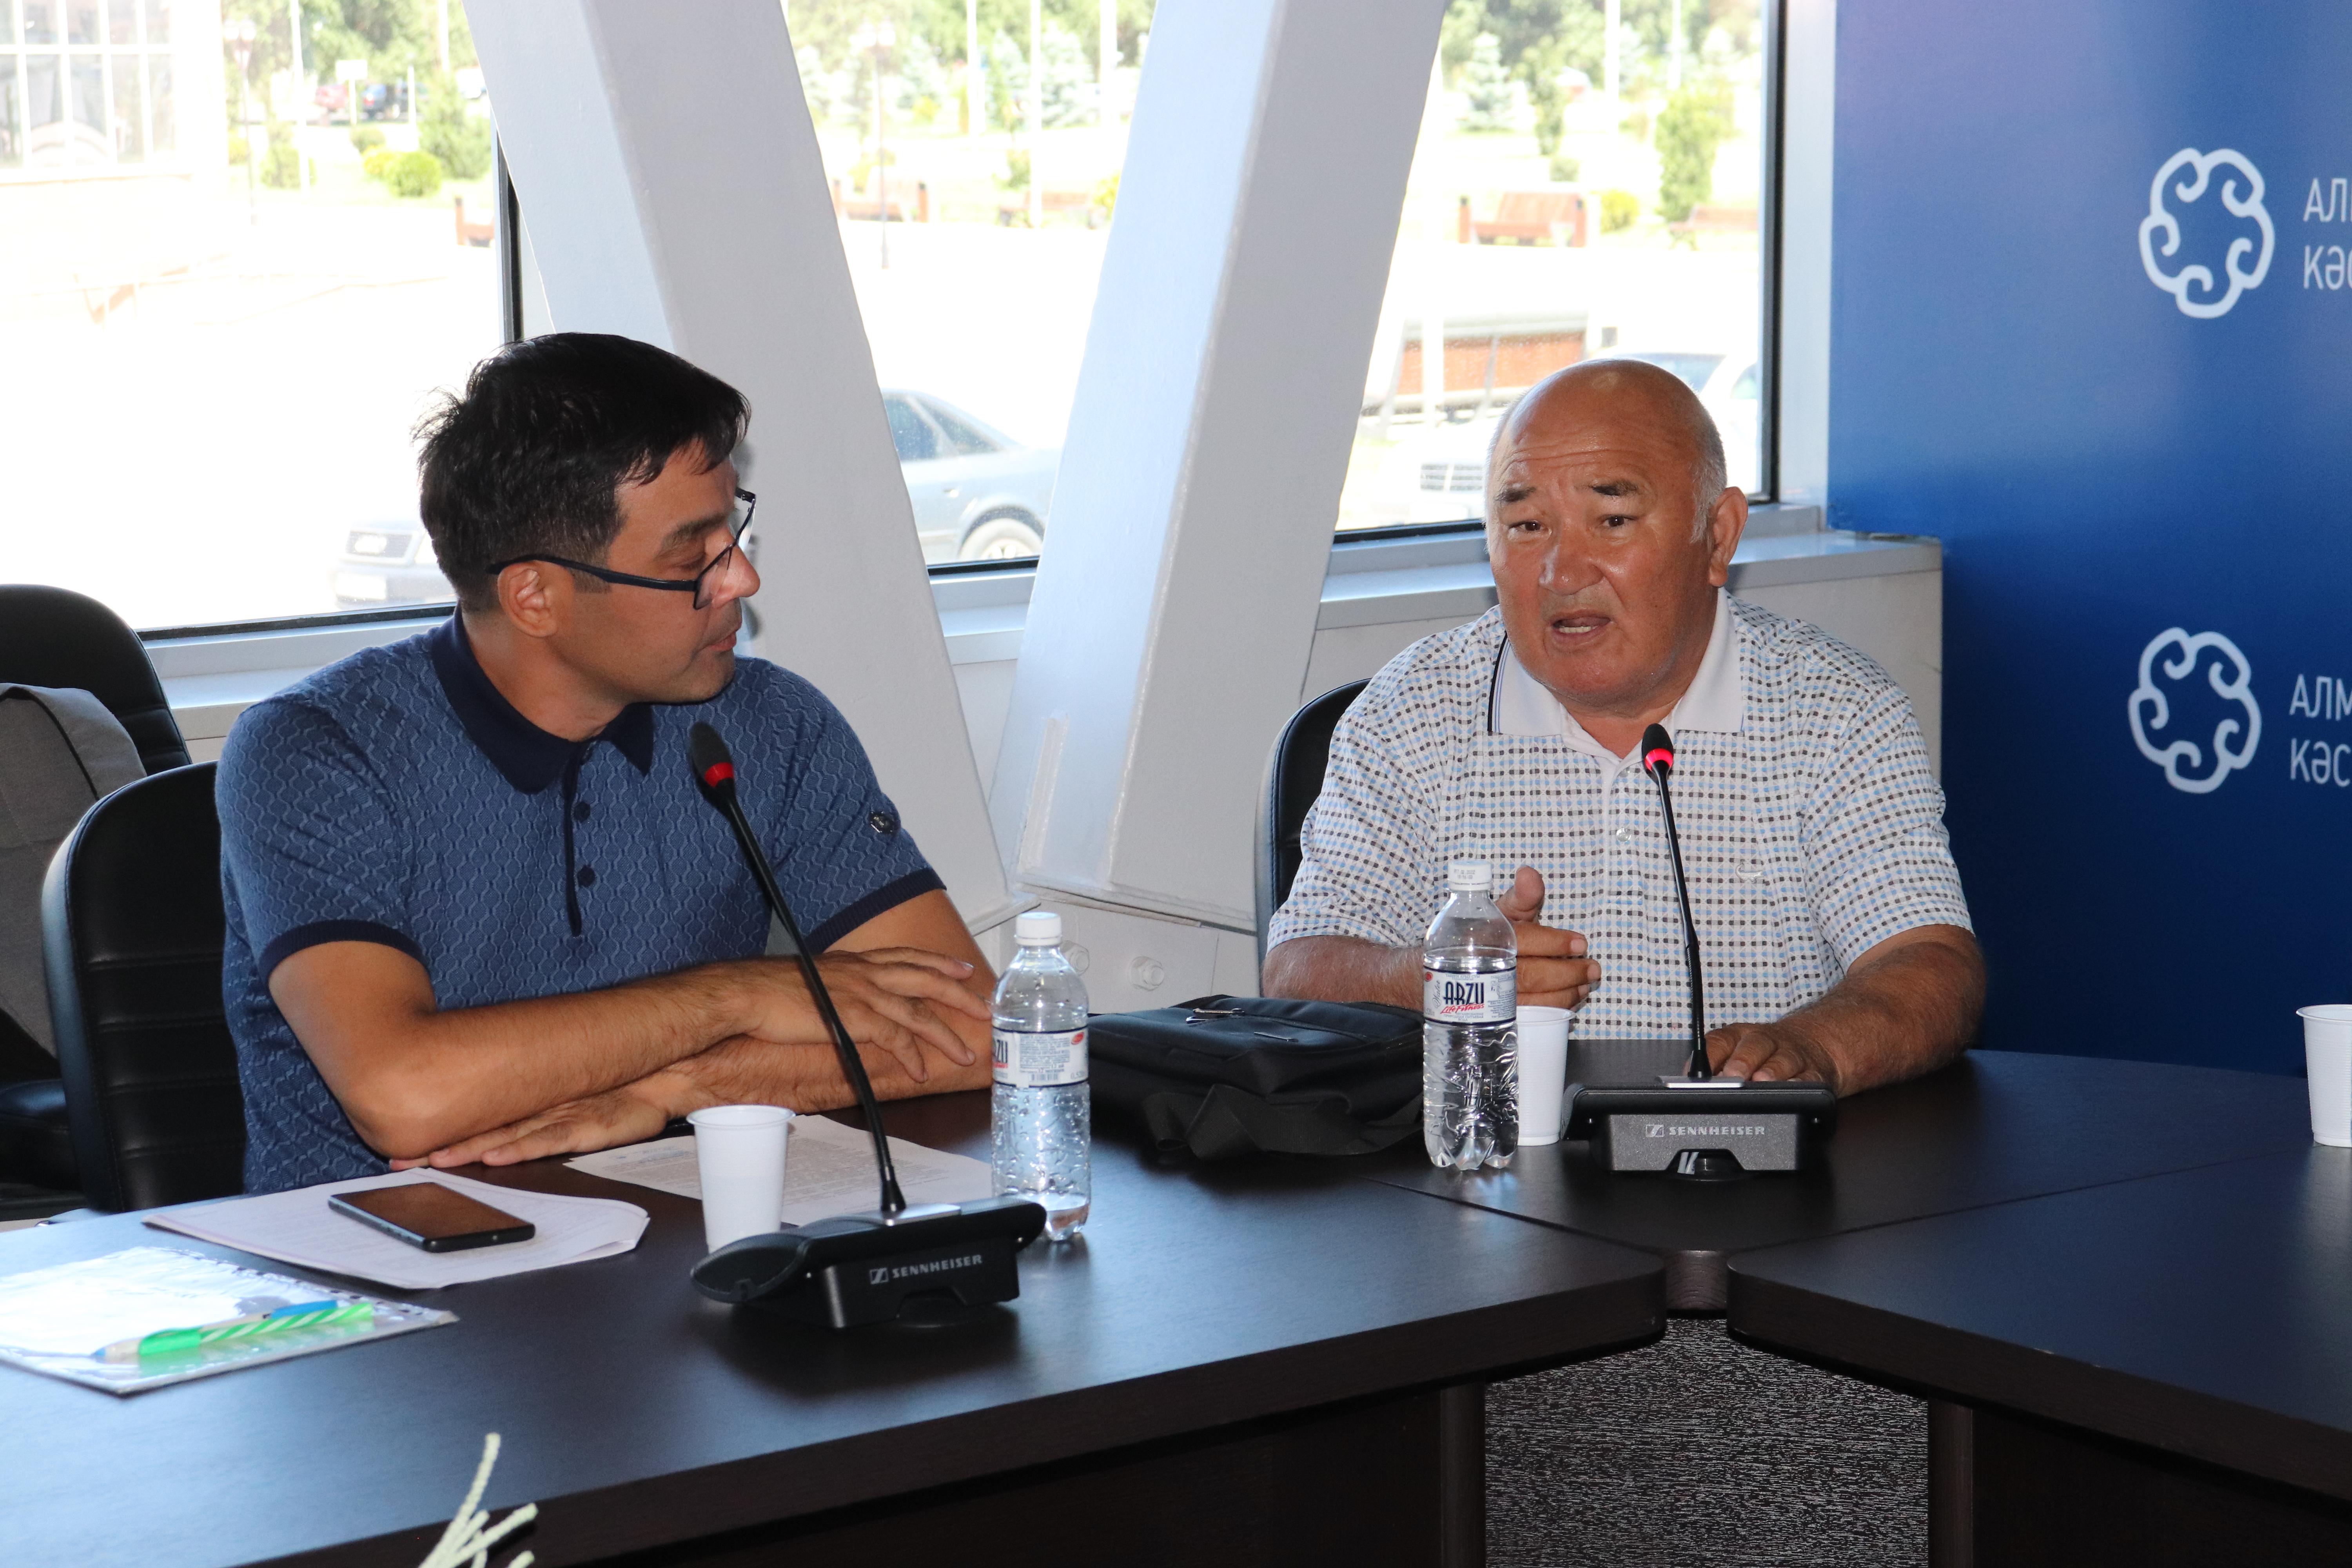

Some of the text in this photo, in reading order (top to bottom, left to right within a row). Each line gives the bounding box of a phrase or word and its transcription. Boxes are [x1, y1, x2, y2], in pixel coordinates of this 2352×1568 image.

[2303, 177, 2352, 223] АЛ
[2303, 245, 2352, 290] КӘ
[2289, 673, 2352, 721] АЛМ
[2290, 737, 2351, 788] КӘС
[1432, 979, 1442, 1009] Water
[1443, 981, 1485, 1005] ARZU
[1669, 1126, 1765, 1136] SENNHEISER
[892, 1254, 983, 1279] SENNHEISER
